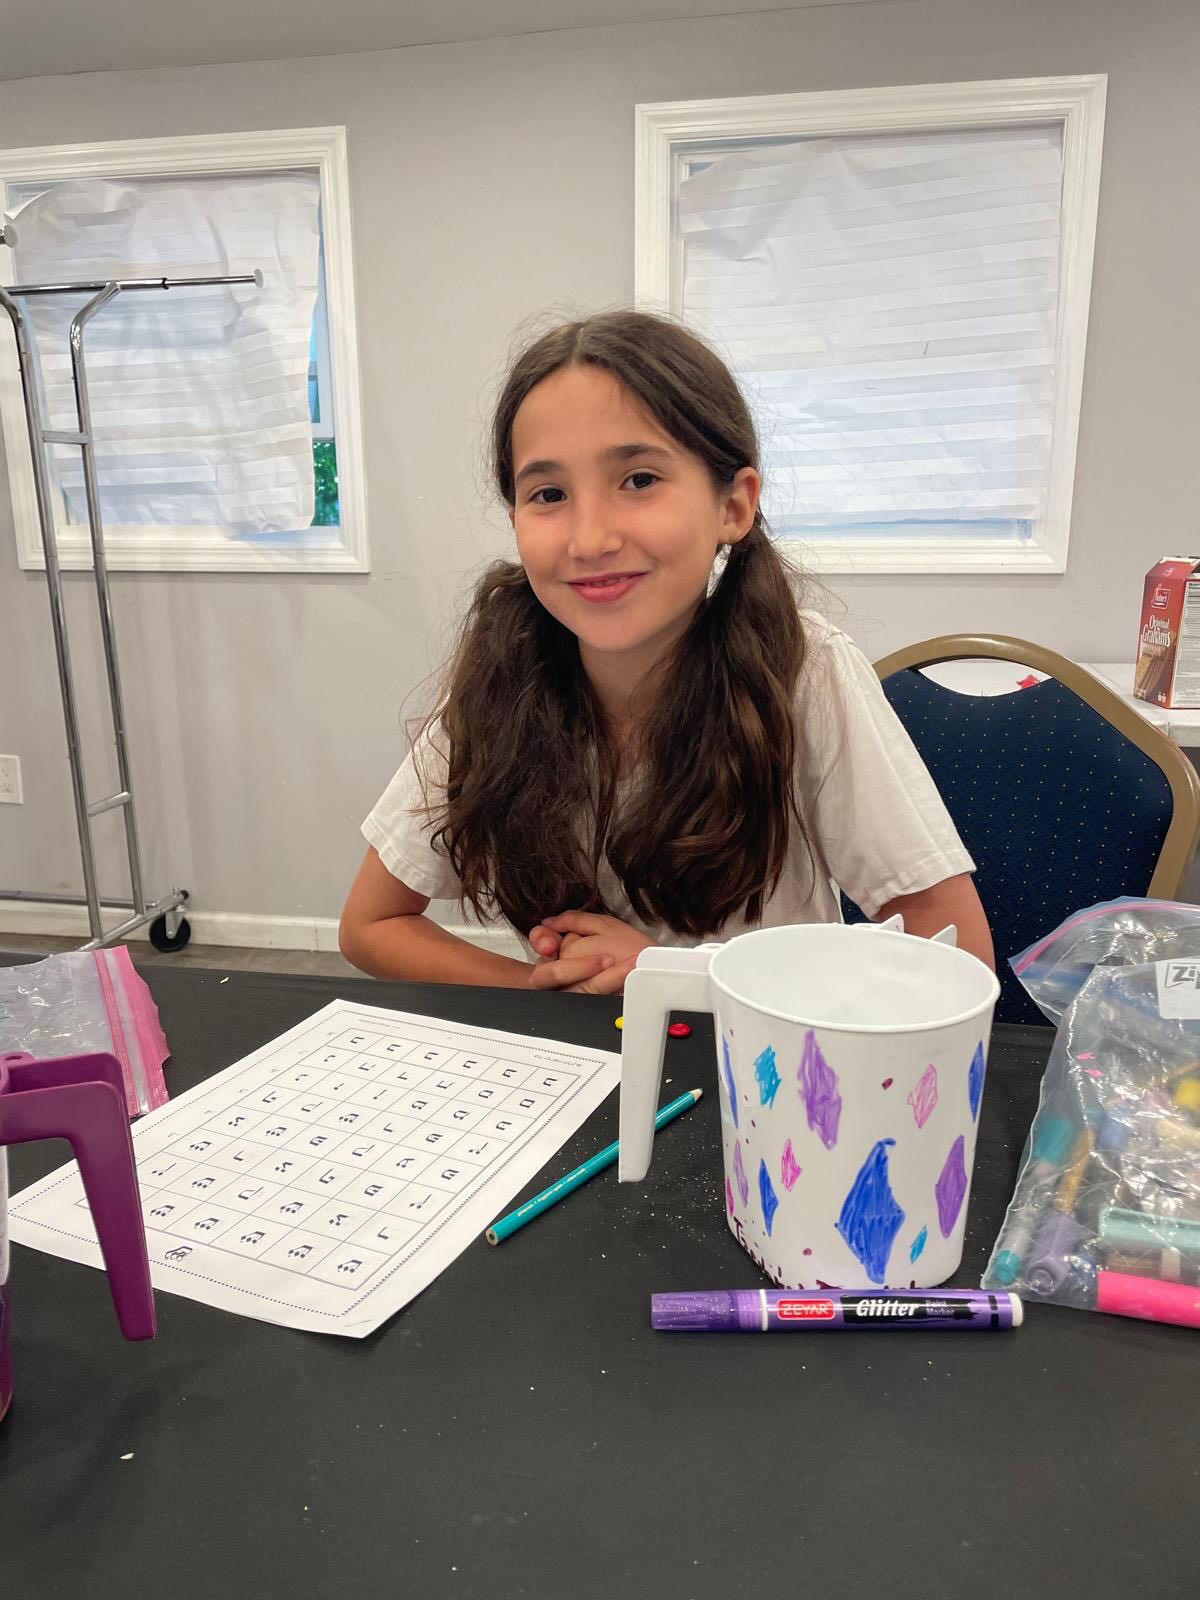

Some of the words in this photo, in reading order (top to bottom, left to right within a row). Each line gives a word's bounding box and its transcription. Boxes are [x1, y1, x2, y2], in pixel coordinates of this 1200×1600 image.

[1142, 624, 1171, 647] Grahams
[782, 1302, 828, 1315] ZEYAR
[855, 1299, 919, 1317] Glitter
